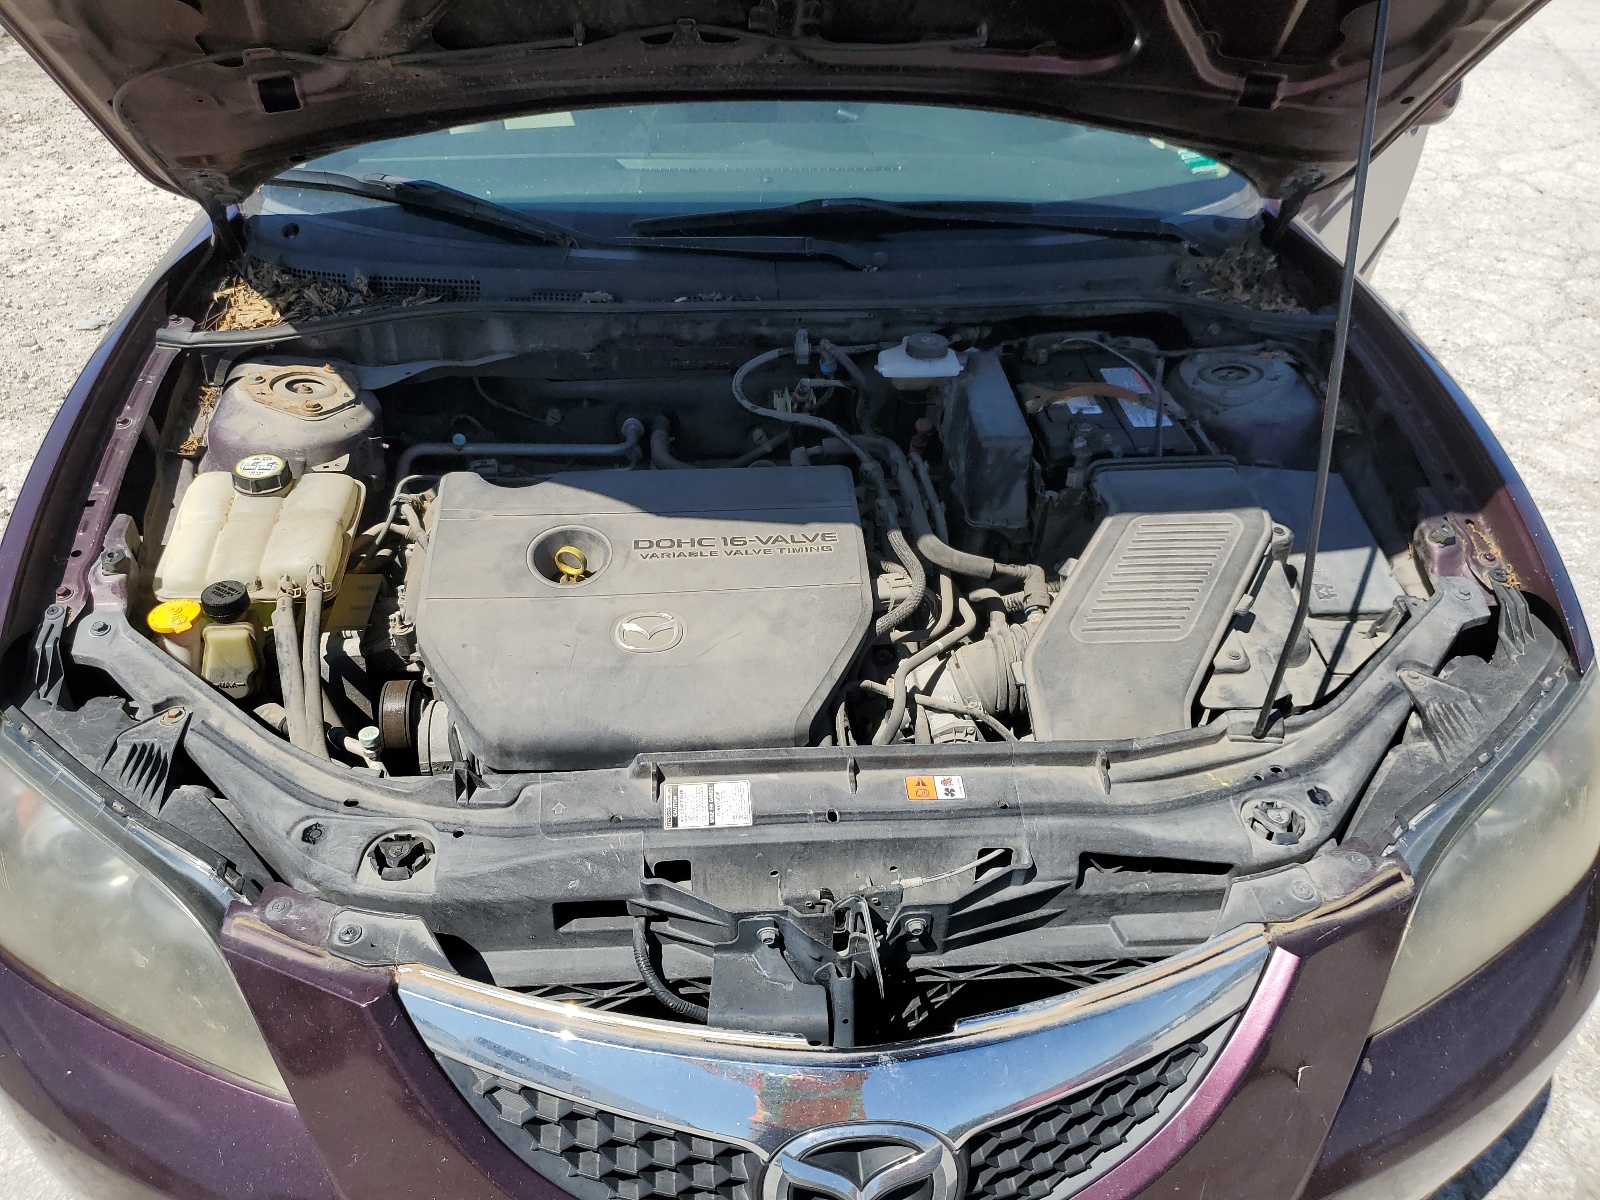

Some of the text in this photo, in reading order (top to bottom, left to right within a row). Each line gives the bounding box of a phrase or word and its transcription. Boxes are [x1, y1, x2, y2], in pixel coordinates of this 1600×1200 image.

[633, 532, 838, 550] DOHC 16-VALVE
[640, 545, 833, 560] VARIABLE VALVE TIMING
